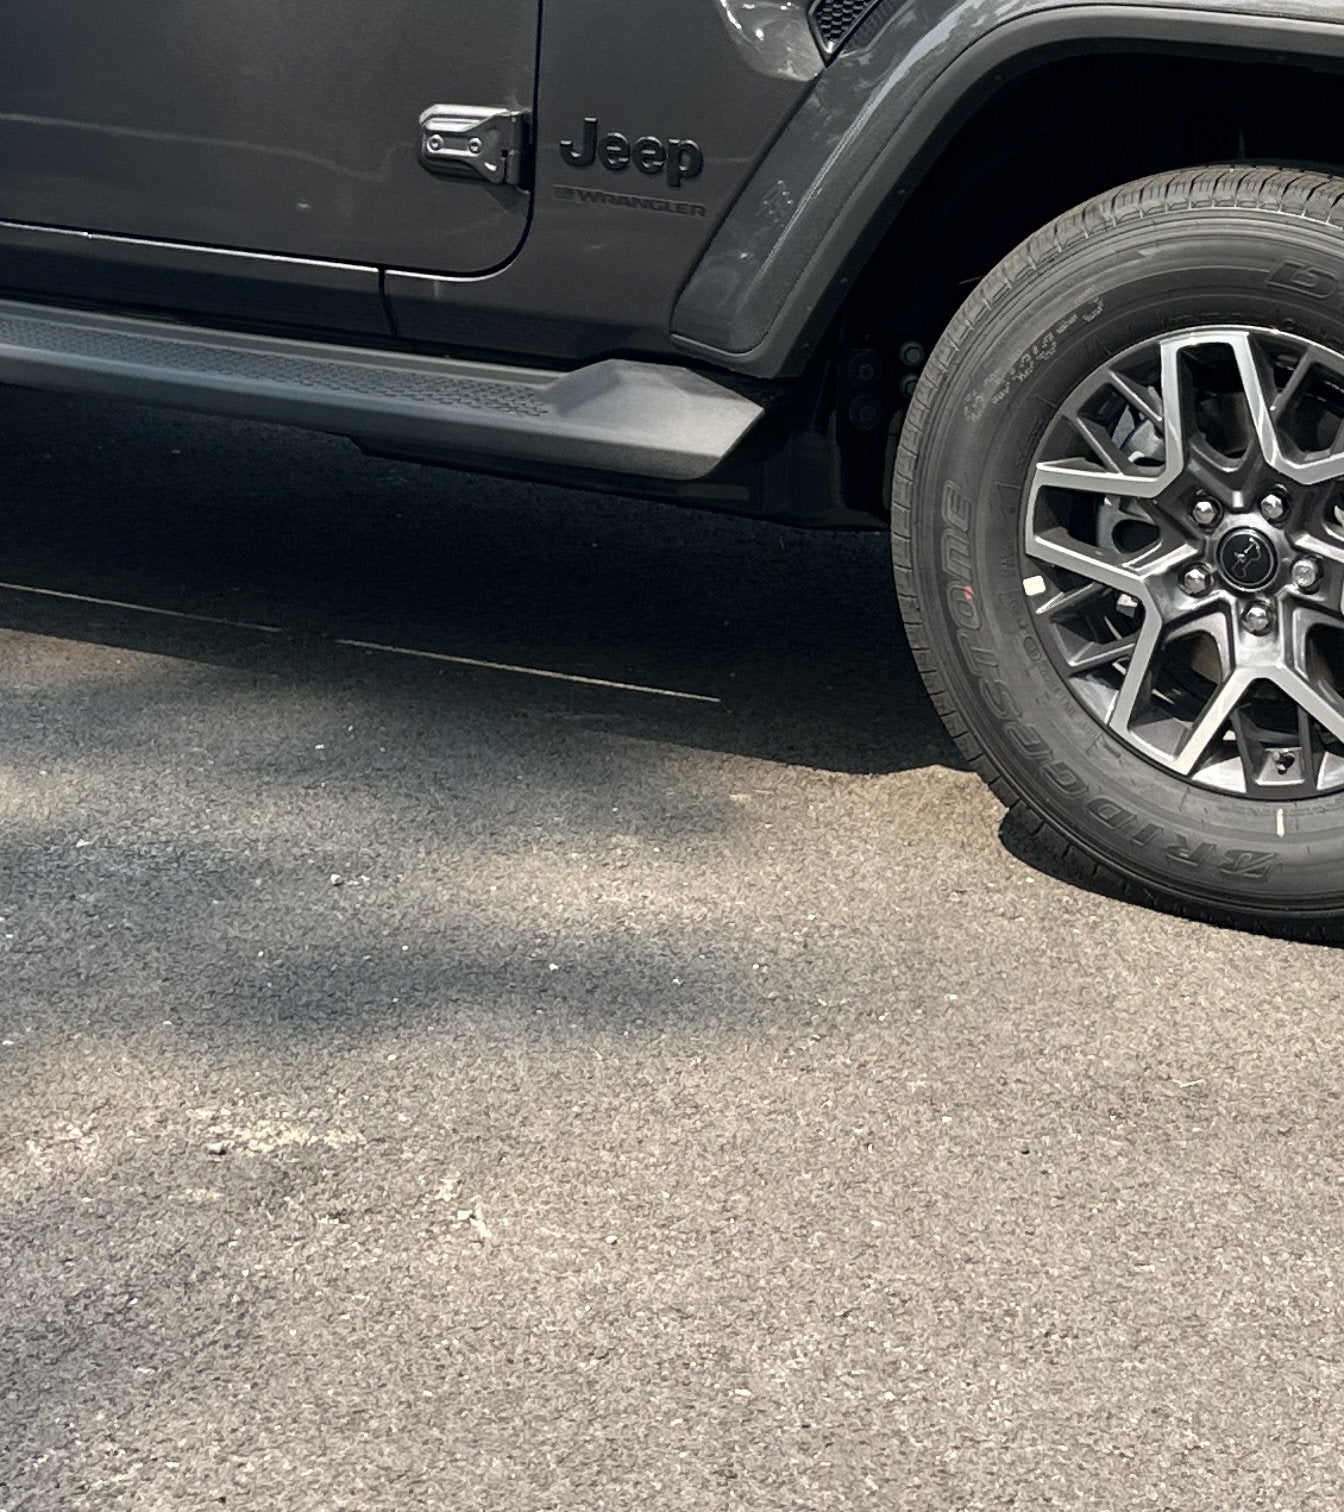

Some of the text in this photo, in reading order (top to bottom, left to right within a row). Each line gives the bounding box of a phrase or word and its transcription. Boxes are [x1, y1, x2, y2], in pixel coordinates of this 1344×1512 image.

[559, 117, 704, 188] Jeep
[577, 188, 706, 218] WRANGLER
[940, 480, 1279, 879] BRIDGESTONE
